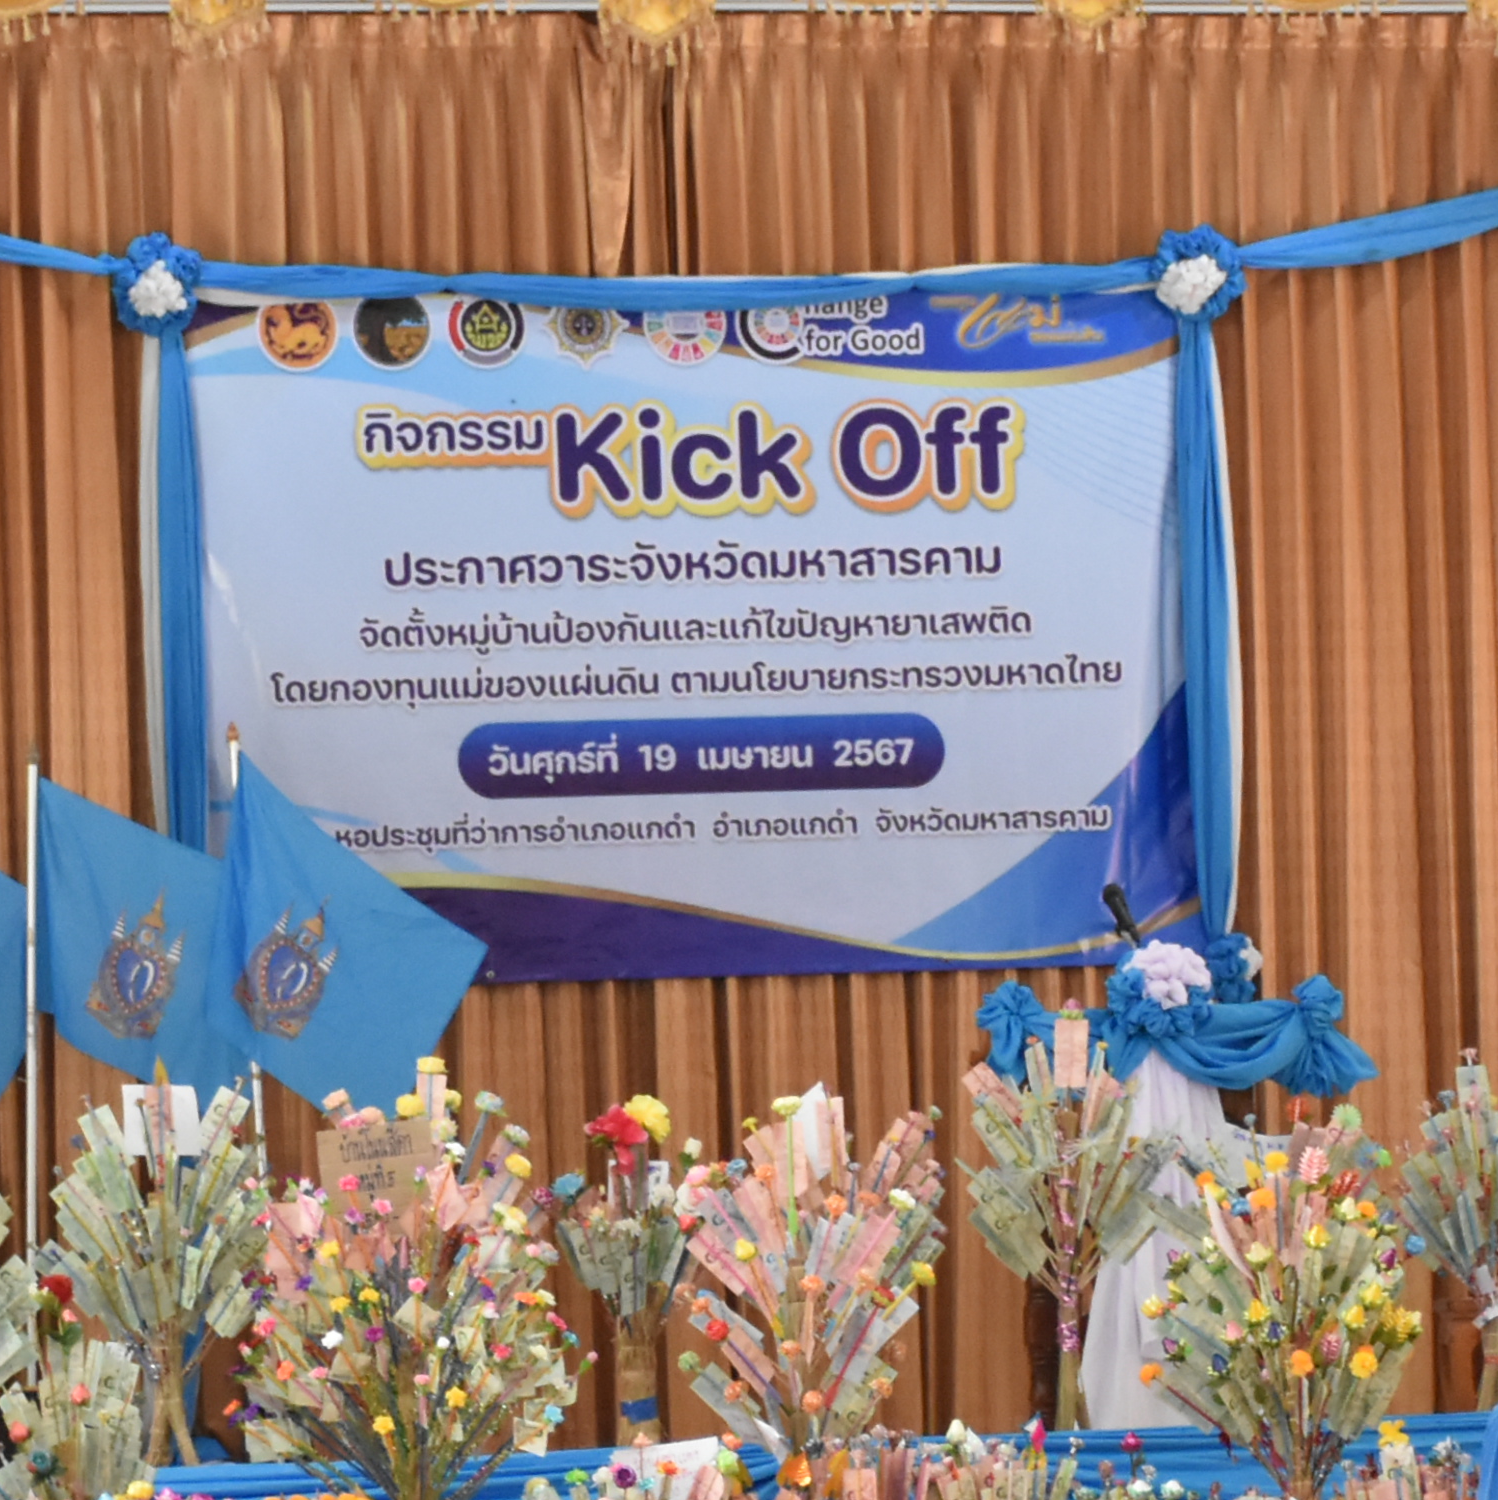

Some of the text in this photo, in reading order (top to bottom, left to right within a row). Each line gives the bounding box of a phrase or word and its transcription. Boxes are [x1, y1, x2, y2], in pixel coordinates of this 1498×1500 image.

[806, 327, 920, 352] for Good
[364, 405, 1011, 502] กิจกรรม Kick Off
[384, 539, 1002, 587] ประกาศวาระจังหวัดมหาสารคาม
[359, 605, 1032, 655] จัดตั้งหมู่บ้านป้องกันและแก้ไขปัญหายาเสพติด
[270, 653, 1123, 709] โดยกองทุนแม่ของแผ่นดิน ตามนโยบายกระทรวงมหาดไทย
[487, 733, 915, 784] วันศุกร์ที่ 19 เมษายน 2567
[712, 808, 858, 838] อำเภอแกดำ
[875, 805, 1109, 834] จังหวัดมหาสารคาม
